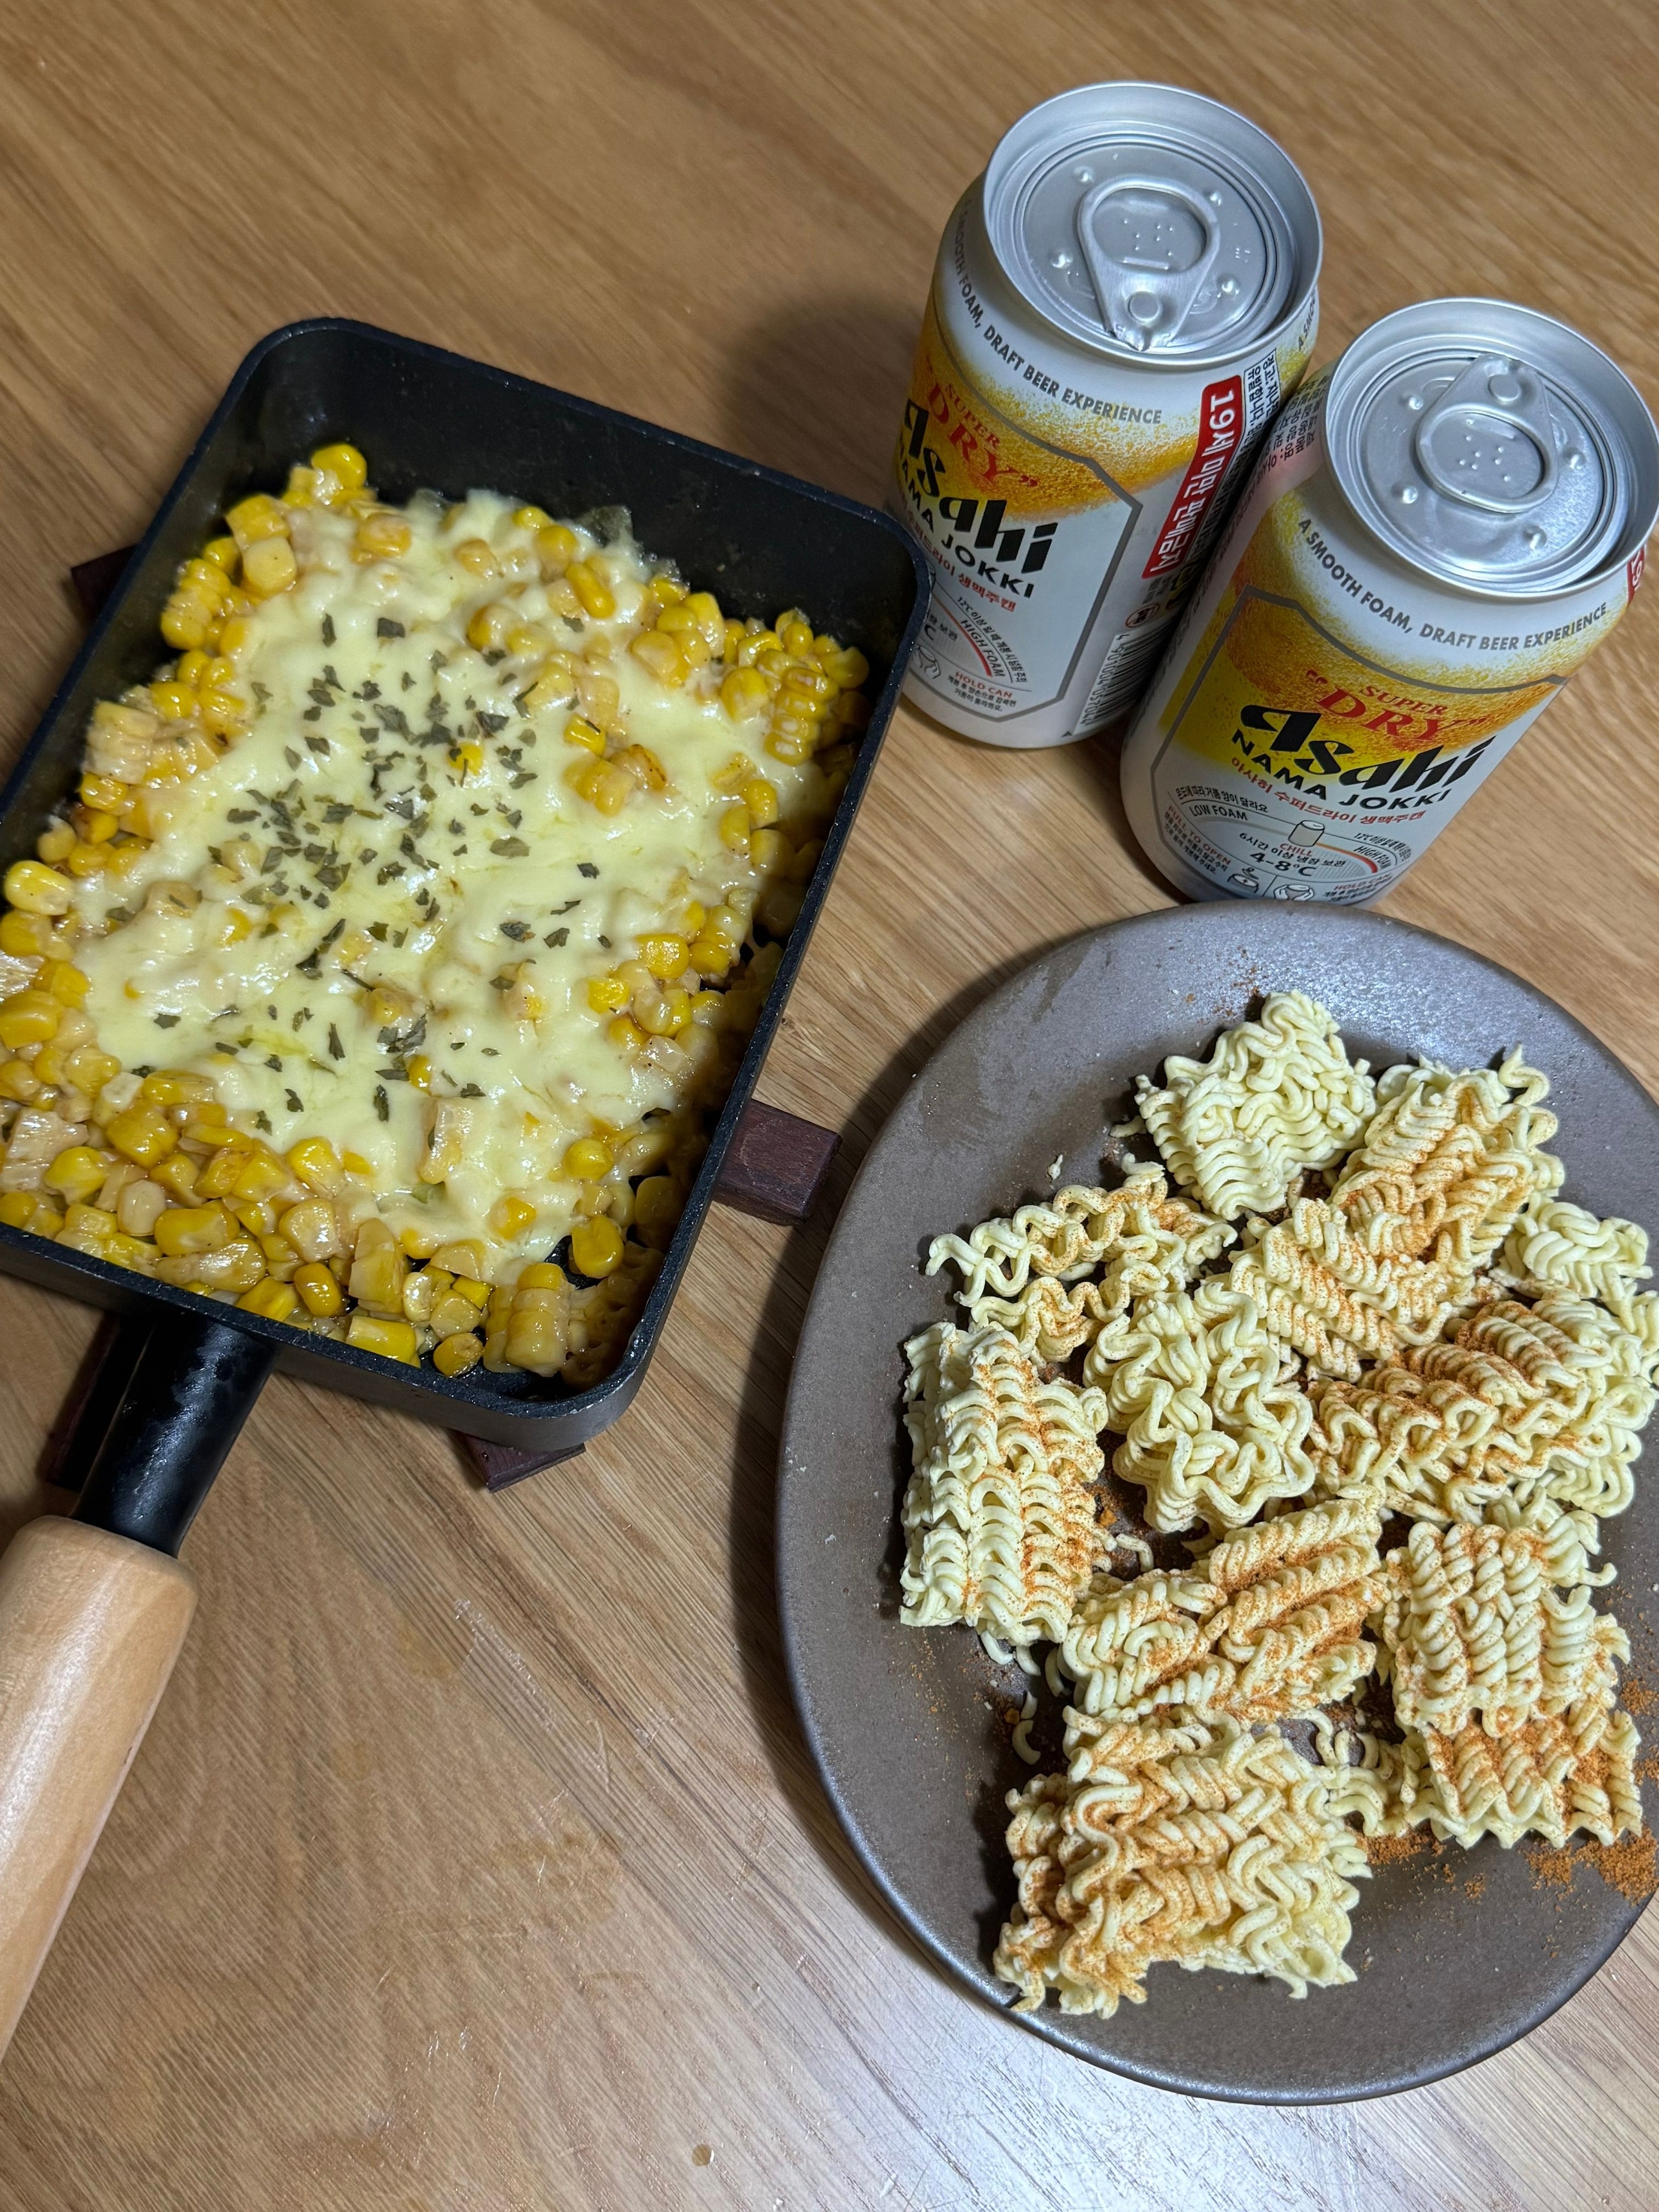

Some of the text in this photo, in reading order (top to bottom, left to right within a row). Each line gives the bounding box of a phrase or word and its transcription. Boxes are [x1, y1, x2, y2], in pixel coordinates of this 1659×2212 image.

[958, 274, 984, 329] FOAM,
[983, 325, 1025, 371] DRAFT
[1023, 364, 1060, 398] BEER
[1062, 387, 1162, 424] EXPERIENCE
[1263, 355, 1276, 385] 경고:
[946, 383, 1001, 450] SUPER
[1247, 366, 1264, 428] 유발합니다.
[1201, 390, 1236, 457] 19세
[904, 398, 1058, 574] Asahi
[1183, 456, 1225, 499] 미만
[1150, 496, 1206, 573] 판매금지
[942, 534, 1034, 598] JOKKI
[1298, 519, 1607, 651] A SMOOTH FOAM, DRAFT BEER EXPERIENCE
[958, 573, 1016, 612] 생맥주캔
[940, 622, 958, 642] 보관
[971, 611, 987, 626] 이상
[1117, 633, 1130, 642] 4
[960, 620, 1005, 677] HIGH FOAM
[955, 671, 1014, 699] HOLD CAN
[1360, 685, 1448, 716] SUPER
[1231, 728, 1452, 810] NAMA JOKKI
[1240, 704, 1497, 793] Asahi
[1175, 785, 1269, 813] 온도에 따라 거품 양이 달라요
[1189, 804, 1248, 821] LOW FOAM
[1231, 756, 1426, 826] 아사히 수퍼드라이 생맥주캔
[1168, 805, 1232, 866] PULL TO OPEN
[1239, 832, 1347, 868] 6시간 이상 냉장 보관
[1279, 843, 1312, 857] CHILL
[1353, 845, 1382, 861] HIGH
[1334, 881, 1367, 891] HOLD
